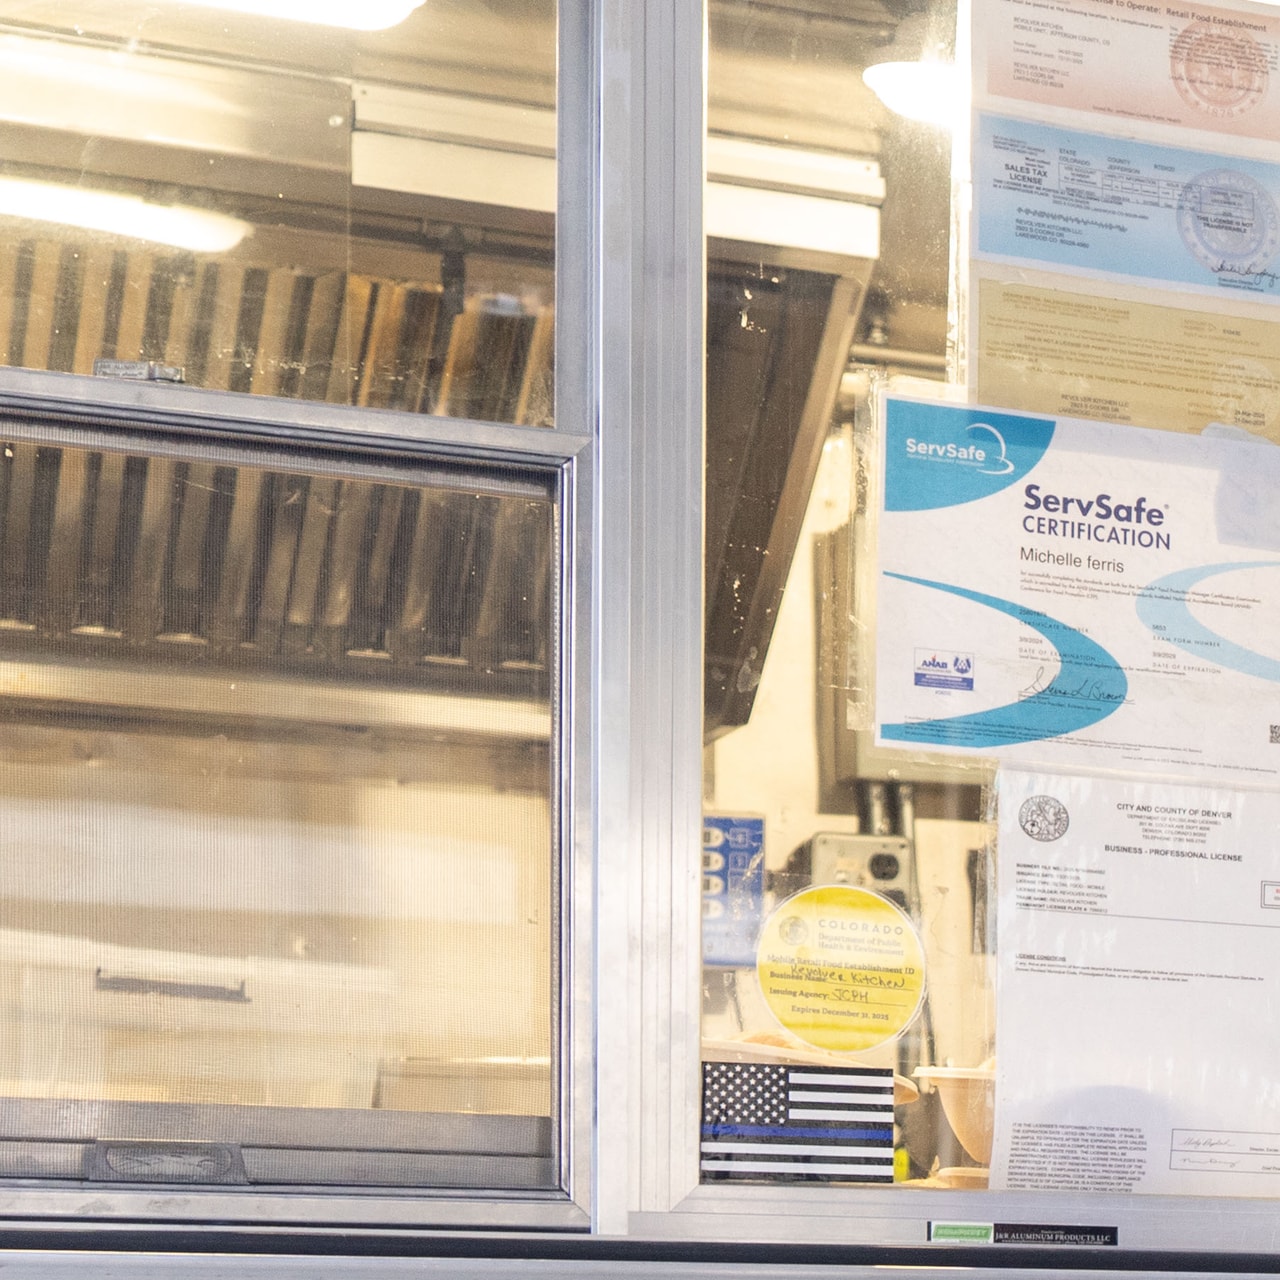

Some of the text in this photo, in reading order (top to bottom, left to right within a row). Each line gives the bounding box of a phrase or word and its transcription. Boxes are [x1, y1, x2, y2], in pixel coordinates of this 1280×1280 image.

[1127, 1, 1161, 14] Operate:
[1166, 8, 1189, 20] Retail
[1191, 12, 1211, 23] Food
[1212, 16, 1267, 32] Establishment
[1059, 156, 1090, 166] COLORADO
[1107, 157, 1131, 165] COUNTY
[1004, 163, 1048, 178] SALES TAX
[1107, 164, 1141, 174] JEFFERSON
[1009, 173, 1043, 186] LICENSE
[1015, 218, 1044, 229] REVOLVER
[1045, 223, 1070, 233] KITCHEN
[1209, 216, 1234, 225] LICENSE
[1015, 232, 1048, 243] LAKEWOOD
[906, 438, 986, 461] ServSafe
[1022, 515, 1171, 550] CERTIFICATION
[1020, 546, 1124, 573] Michelle ferris
[1153, 635, 1221, 648] EXAM FORM NUMBER
[1019, 647, 1035, 655] DATE
[1050, 651, 1096, 661] EXAMINATION
[1152, 662, 1169, 670] DATE
[1183, 666, 1221, 674] EXPIRATION
[1117, 803, 1232, 819] CITY AND COUNTY OF DENVER
[1104, 844, 1143, 855] BUSINESS
[1149, 848, 1208, 860] PROFESSIONAL
[1210, 853, 1243, 863] LICENSE
[818, 918, 904, 936] COLORADO
[818, 933, 901, 947] Department of Public
[818, 942, 844, 951] Health
[854, 944, 904, 956] Environment
[767, 954, 915, 975] Mobile Retail Food Establishment ID
[769, 971, 805, 981] Business
[769, 987, 830, 1000] Issuing Agency:
[832, 988, 869, 1003] JCPH
[791, 1005, 821, 1015] Expires
[822, 1007, 860, 1018] December
[872, 1012, 889, 1020] 2025
[995, 1232, 1010, 1240] J&R
[1011, 1233, 1053, 1241] ALUMINUM
[1054, 1234, 1096, 1242] PRODUCTS
